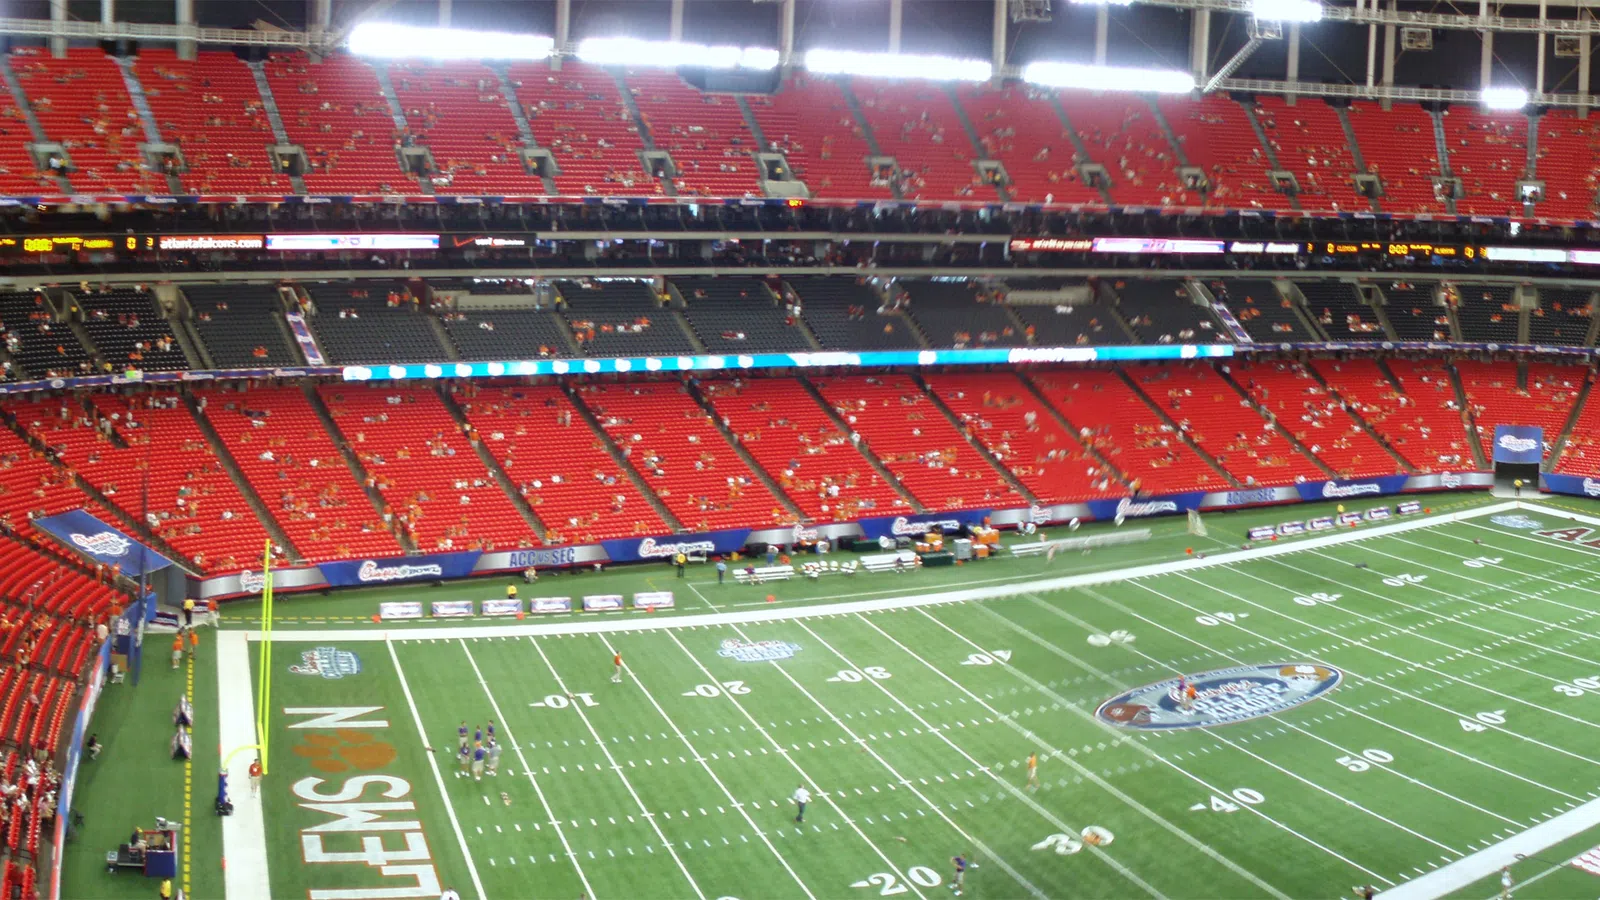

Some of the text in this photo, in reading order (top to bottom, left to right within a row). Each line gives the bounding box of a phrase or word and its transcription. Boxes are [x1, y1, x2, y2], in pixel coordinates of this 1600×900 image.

[160, 237, 263, 250] atlantafalcons.com
[510, 551, 536, 567] ACC
[552, 548, 575, 564] SEC
[837, 666, 892, 682] 30
[695, 680, 752, 698] 20
[544, 693, 600, 709] 10
[1459, 711, 1506, 732] 40
[1335, 748, 1394, 772] 50
[1210, 787, 1265, 812] 40
[868, 866, 942, 896] 20
